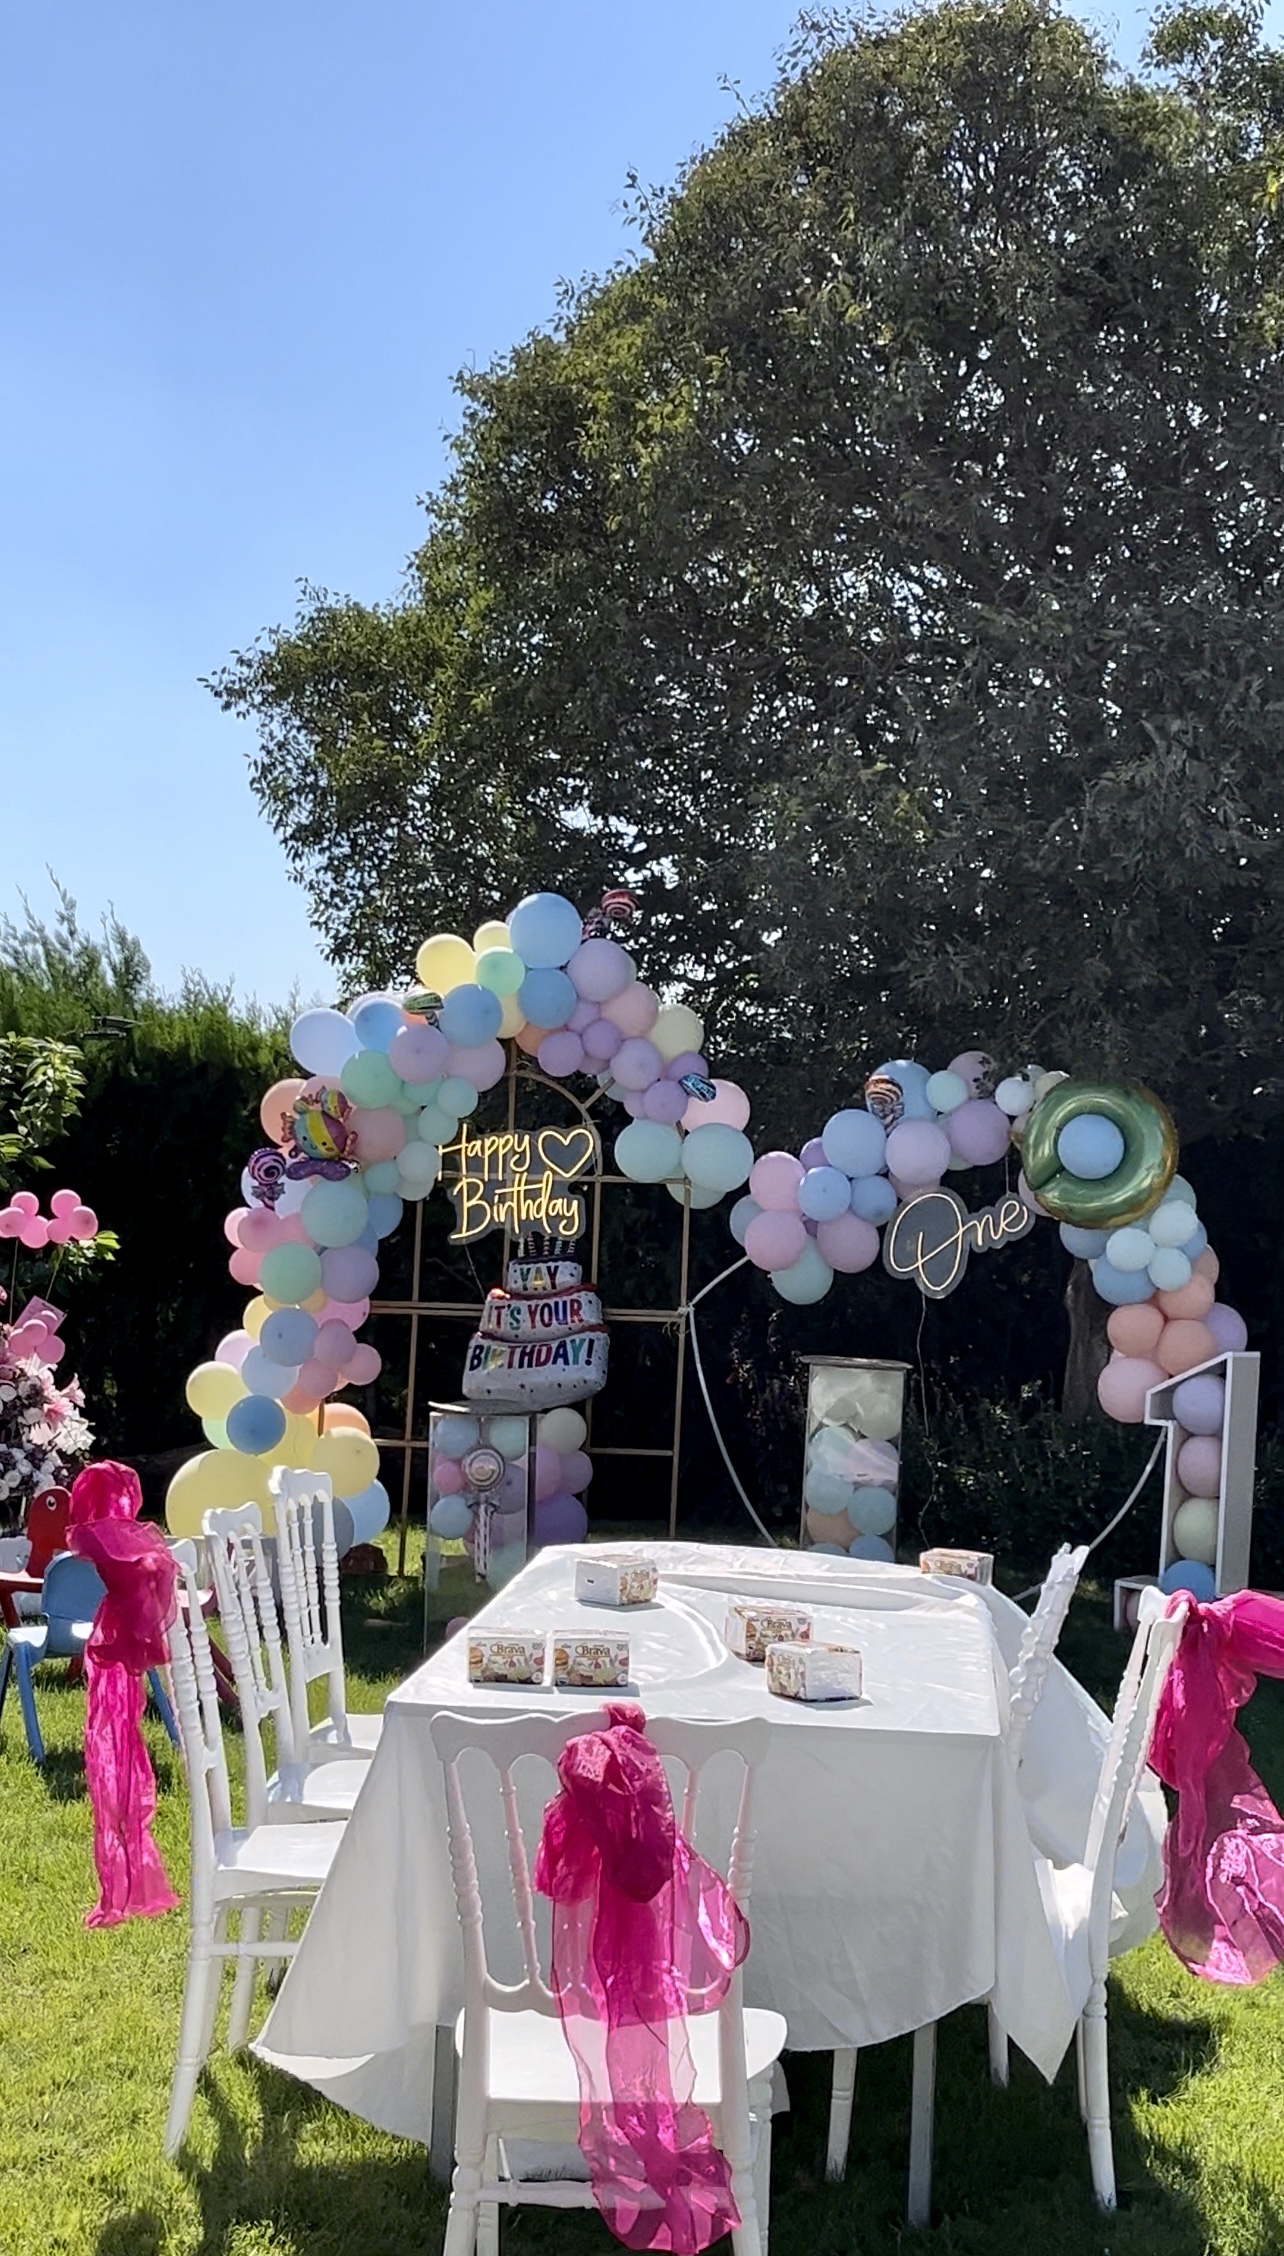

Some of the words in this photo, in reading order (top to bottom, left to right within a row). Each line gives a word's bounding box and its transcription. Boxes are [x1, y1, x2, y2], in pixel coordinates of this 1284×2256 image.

[438, 1122, 531, 1182] Happy
[450, 1170, 580, 1239] Birthday
[889, 1193, 1028, 1291] One
[519, 1265, 559, 1291] YAY
[487, 1303, 522, 1331] IT'S
[527, 1298, 584, 1330] YOUR
